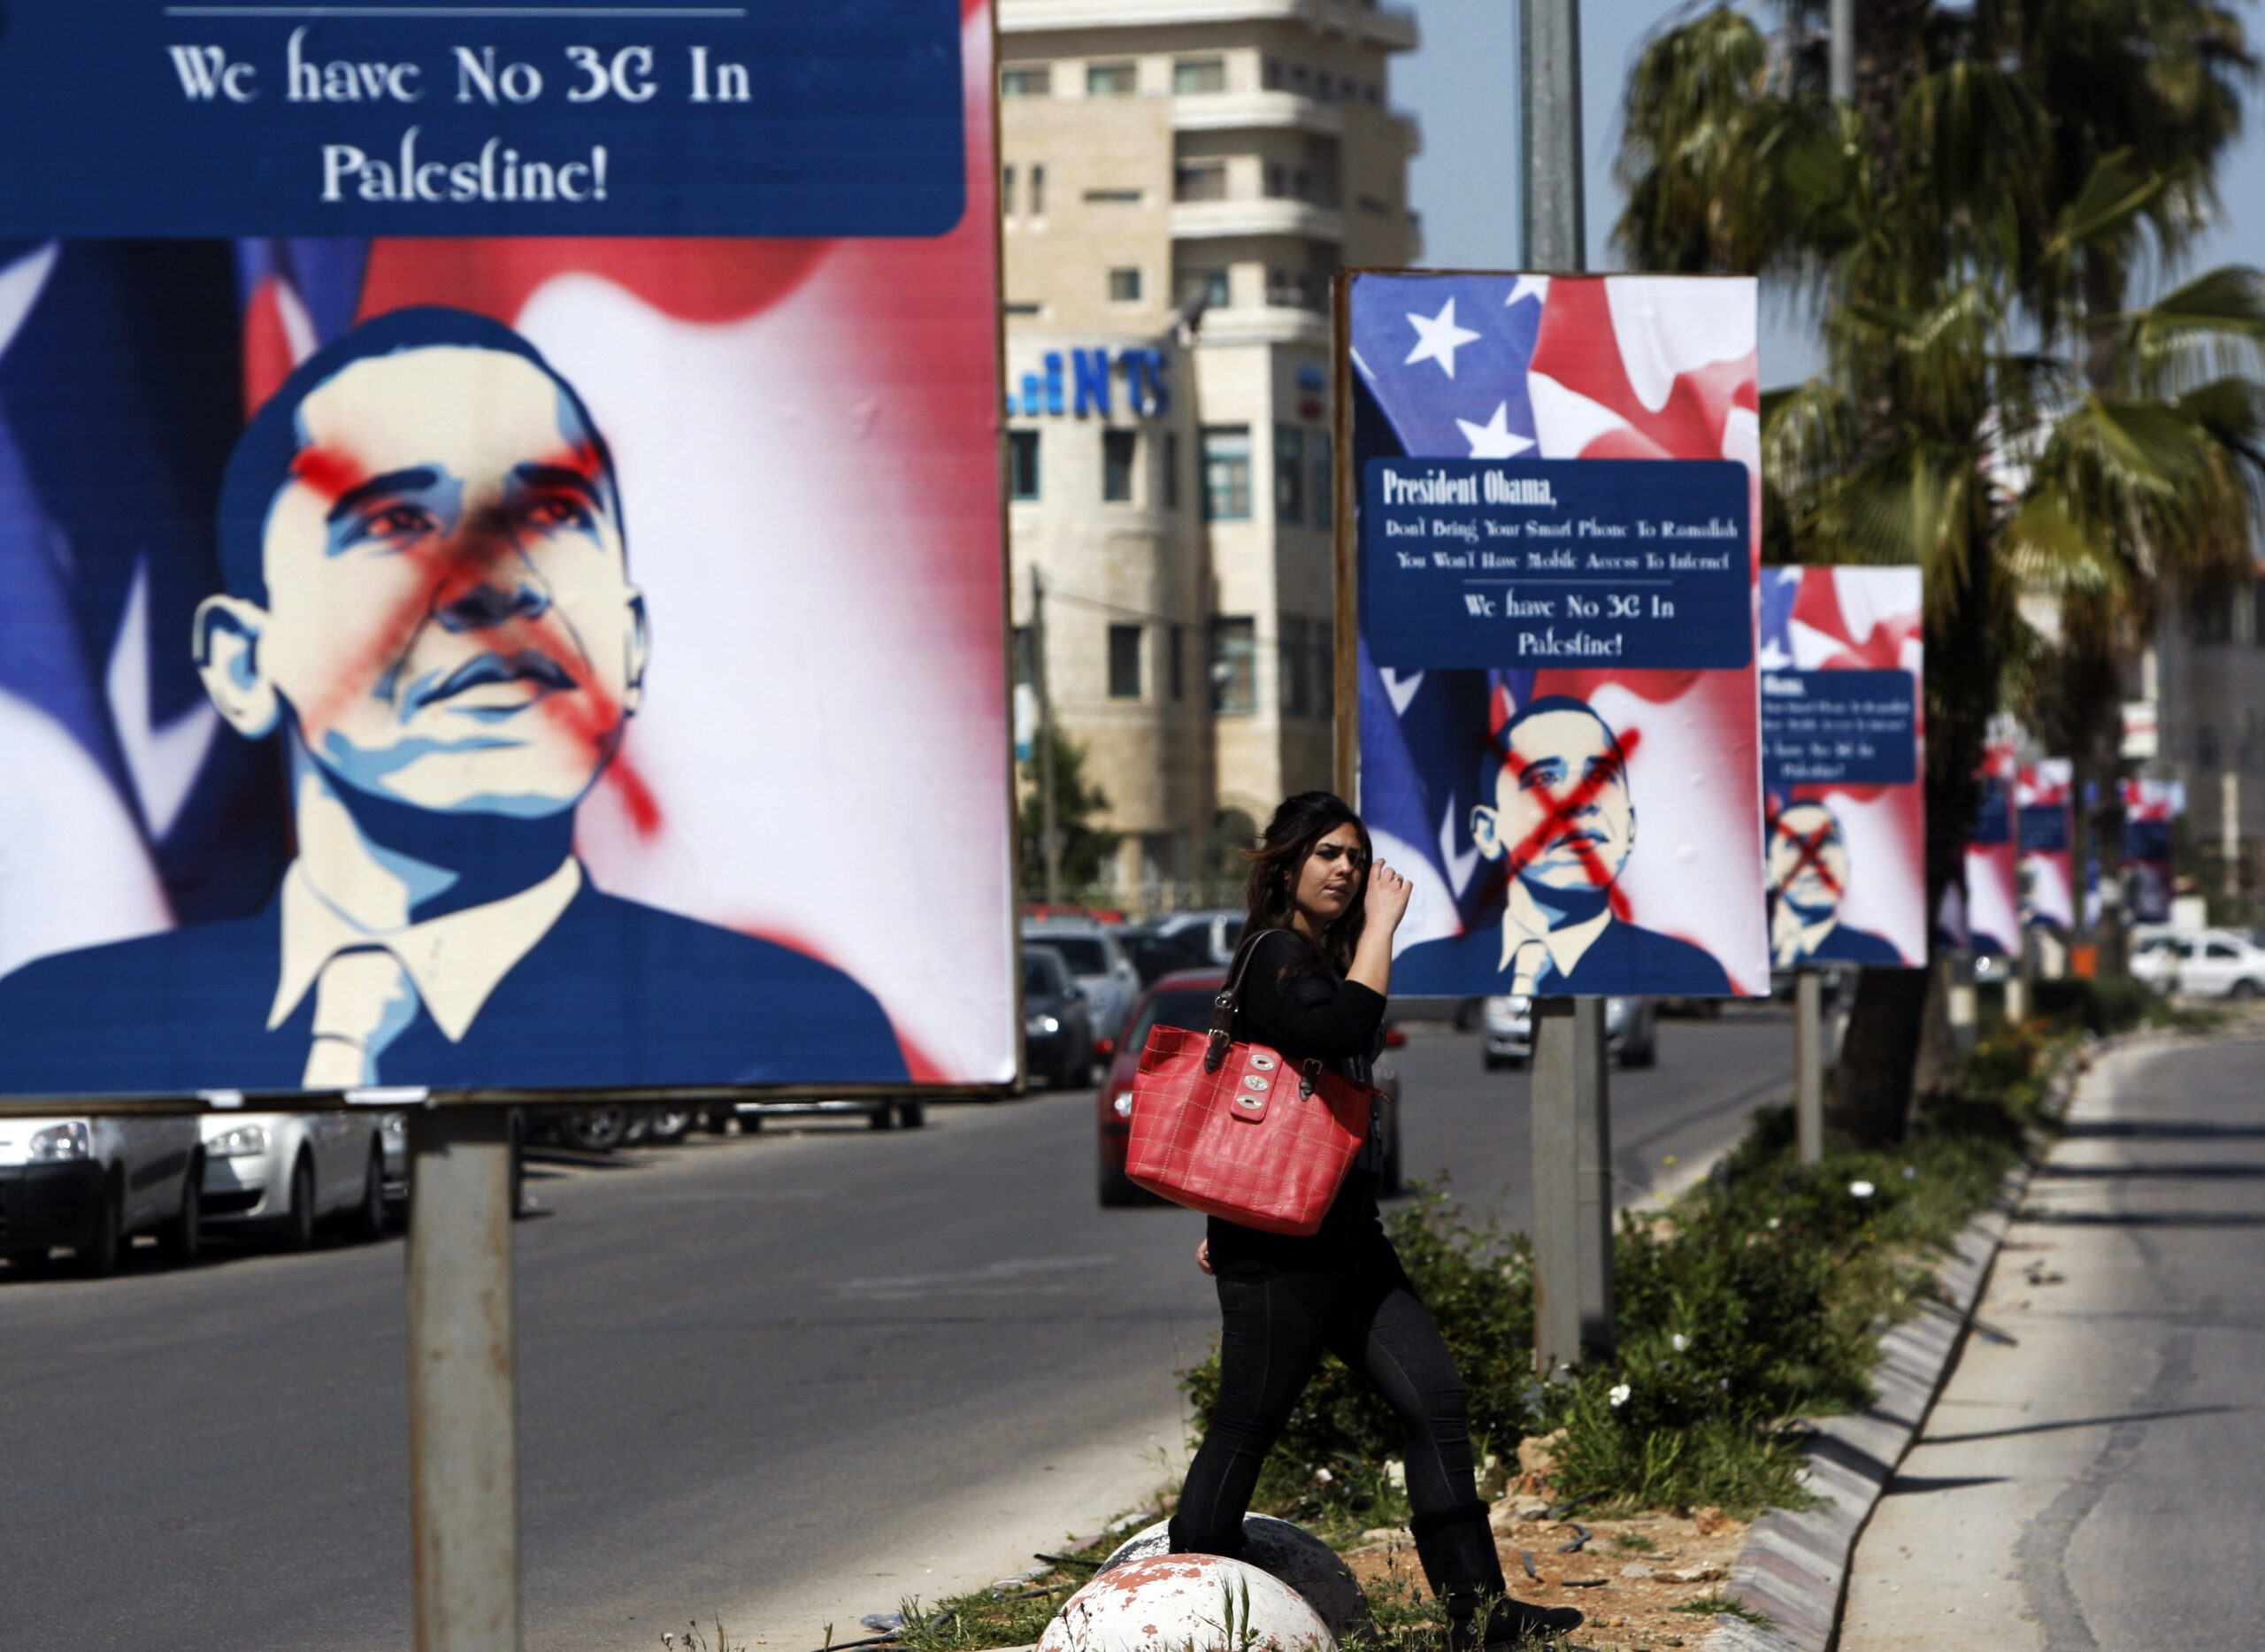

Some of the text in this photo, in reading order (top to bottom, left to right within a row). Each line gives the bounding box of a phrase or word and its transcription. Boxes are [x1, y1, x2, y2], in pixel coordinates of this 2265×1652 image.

[168, 26, 751, 106] We have No 3G In
[320, 125, 608, 202] Palestine!
[1383, 469, 1557, 511] President Obama,
[1432, 518, 1480, 544] Bring
[1483, 519, 1521, 537] Your
[1524, 519, 1571, 537] Smart
[1578, 516, 1628, 538] Phone
[1636, 519, 1656, 538] To
[1662, 516, 1739, 539] Ramallah
[1396, 550, 1426, 569] You
[1481, 551, 1520, 569] Have
[1526, 546, 1578, 570] Mobile
[1586, 552, 1639, 569] Access
[1645, 552, 1664, 569] To
[1670, 550, 1730, 570] Internet
[1463, 587, 1675, 619] We have No 3G In
[1518, 626, 1623, 656] Palestine!
